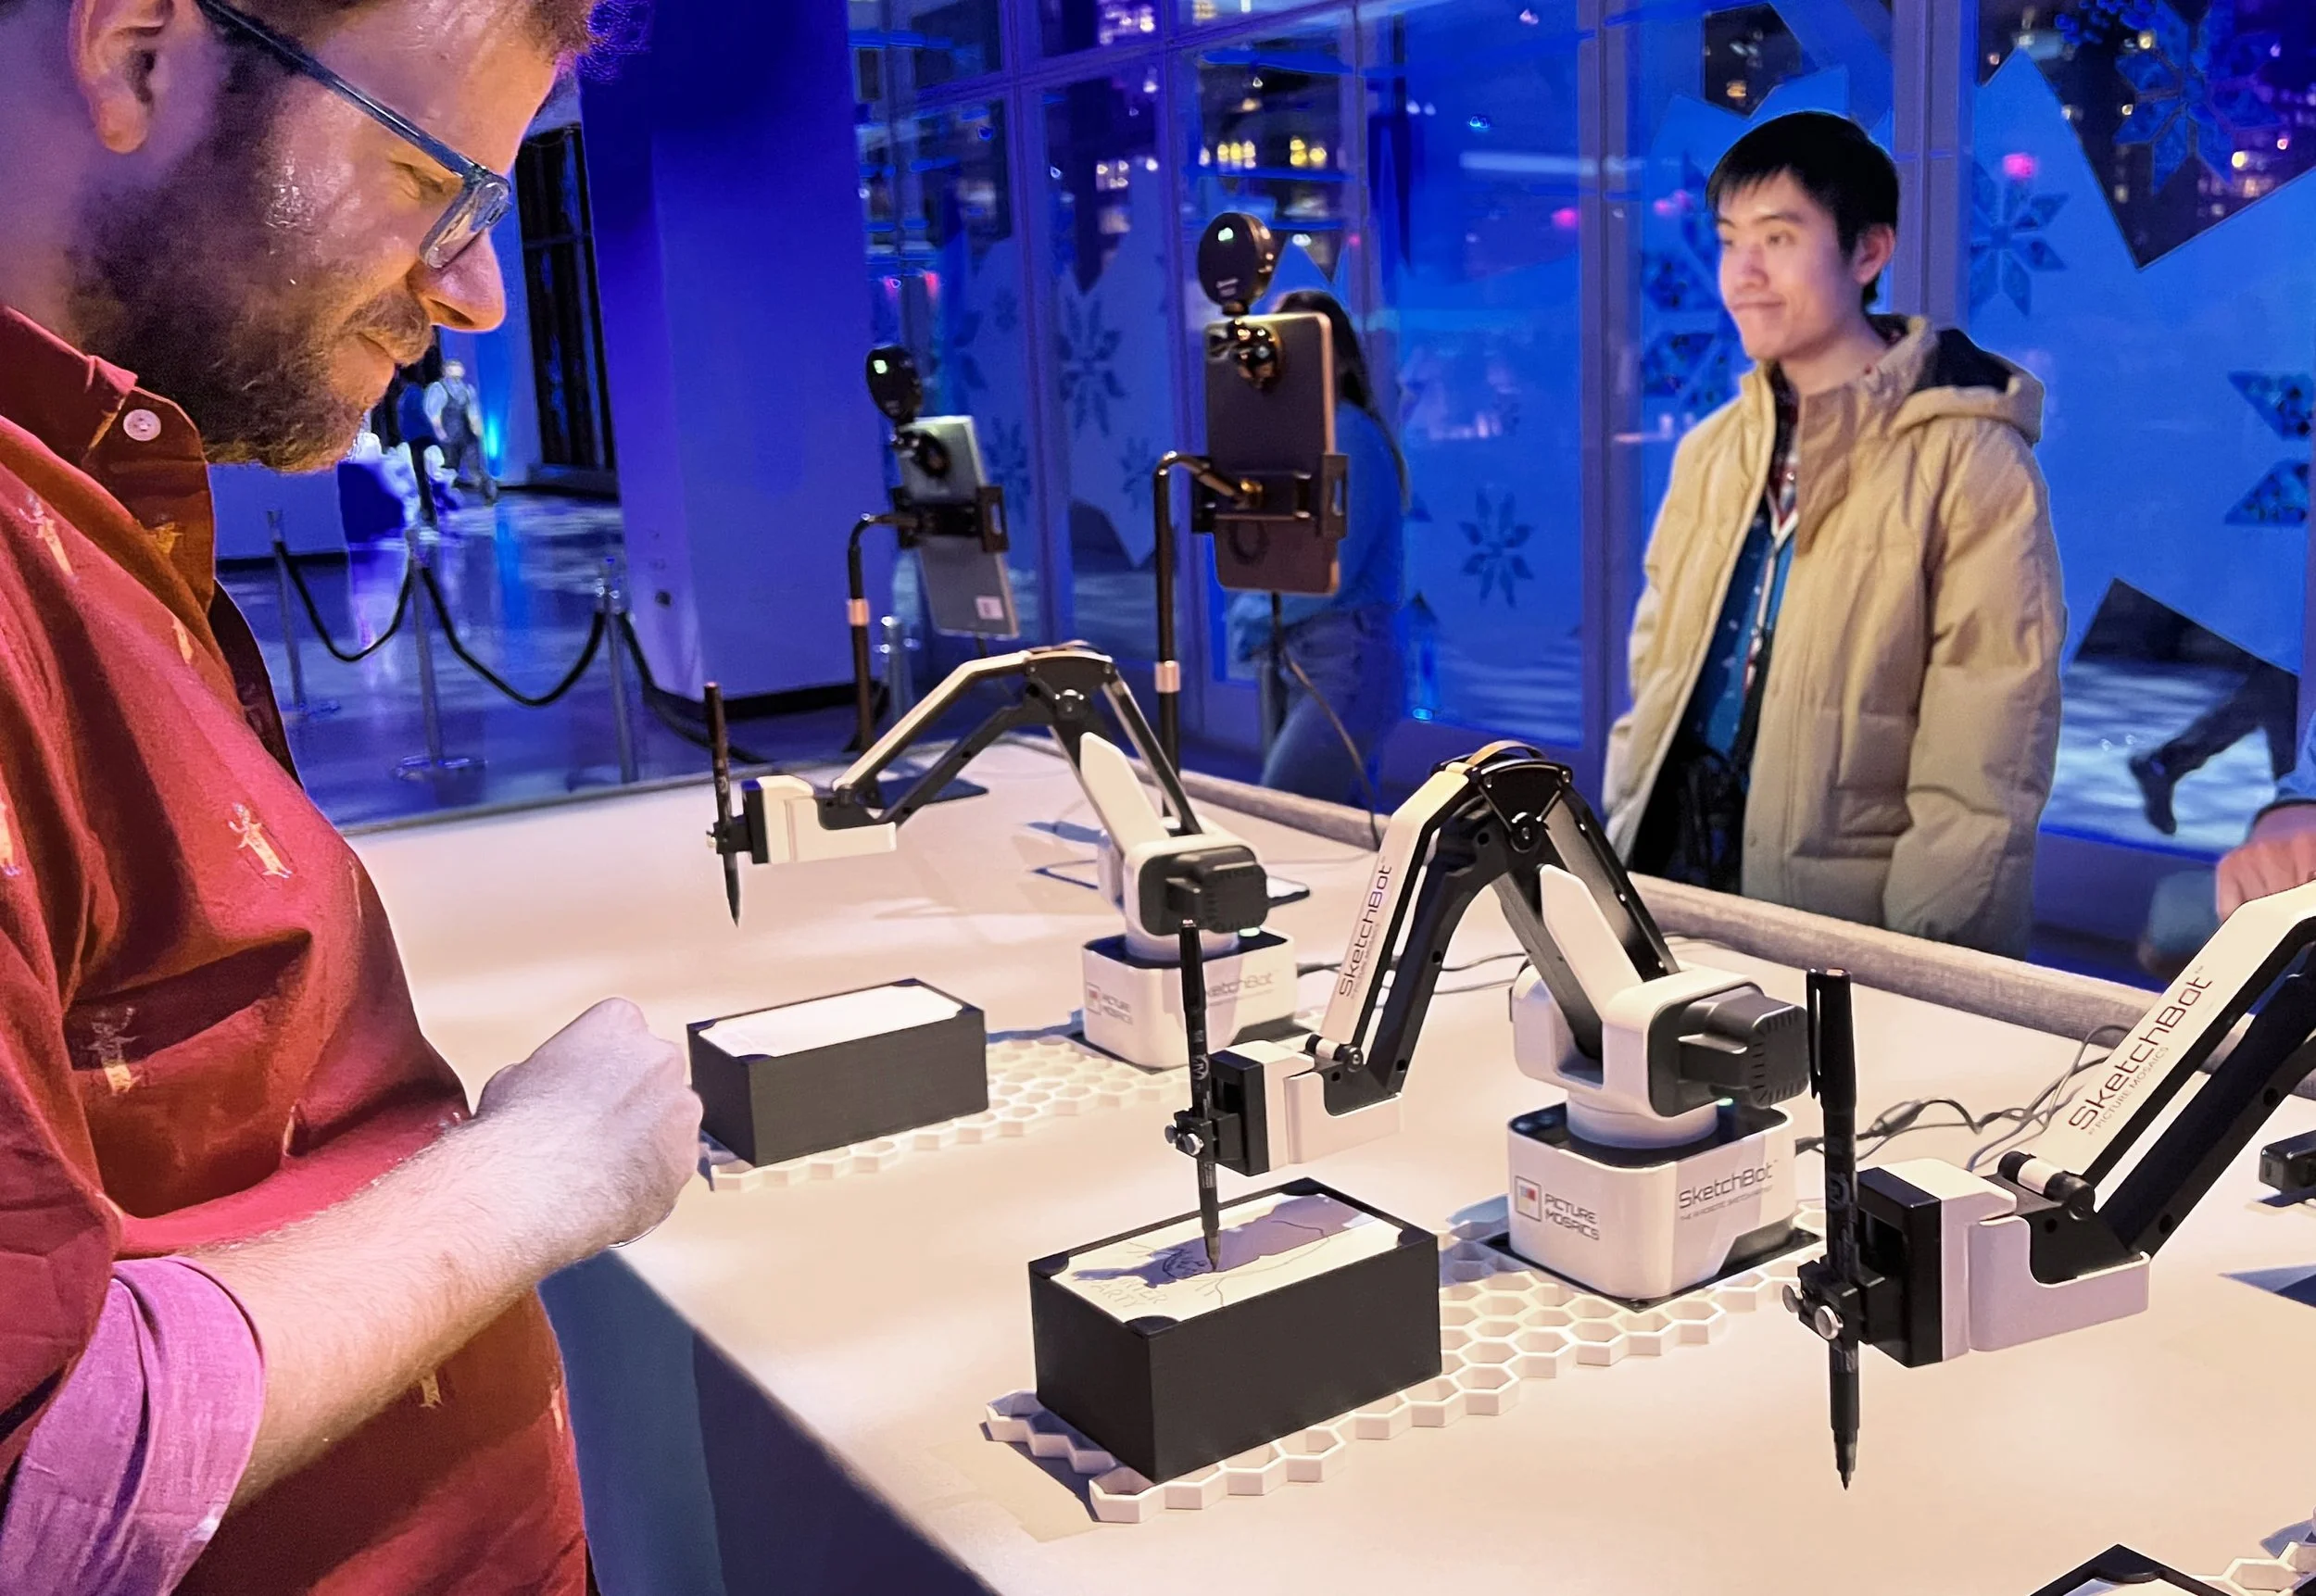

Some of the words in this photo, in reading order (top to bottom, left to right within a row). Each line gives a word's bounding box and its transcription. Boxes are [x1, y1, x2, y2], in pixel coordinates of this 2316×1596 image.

[1339, 864, 1392, 998] SketchBot
[2068, 976, 2213, 1131] SketchBot
[1544, 1192, 1598, 1225] PICTURE
[1678, 1161, 1774, 1210] SketchBot
